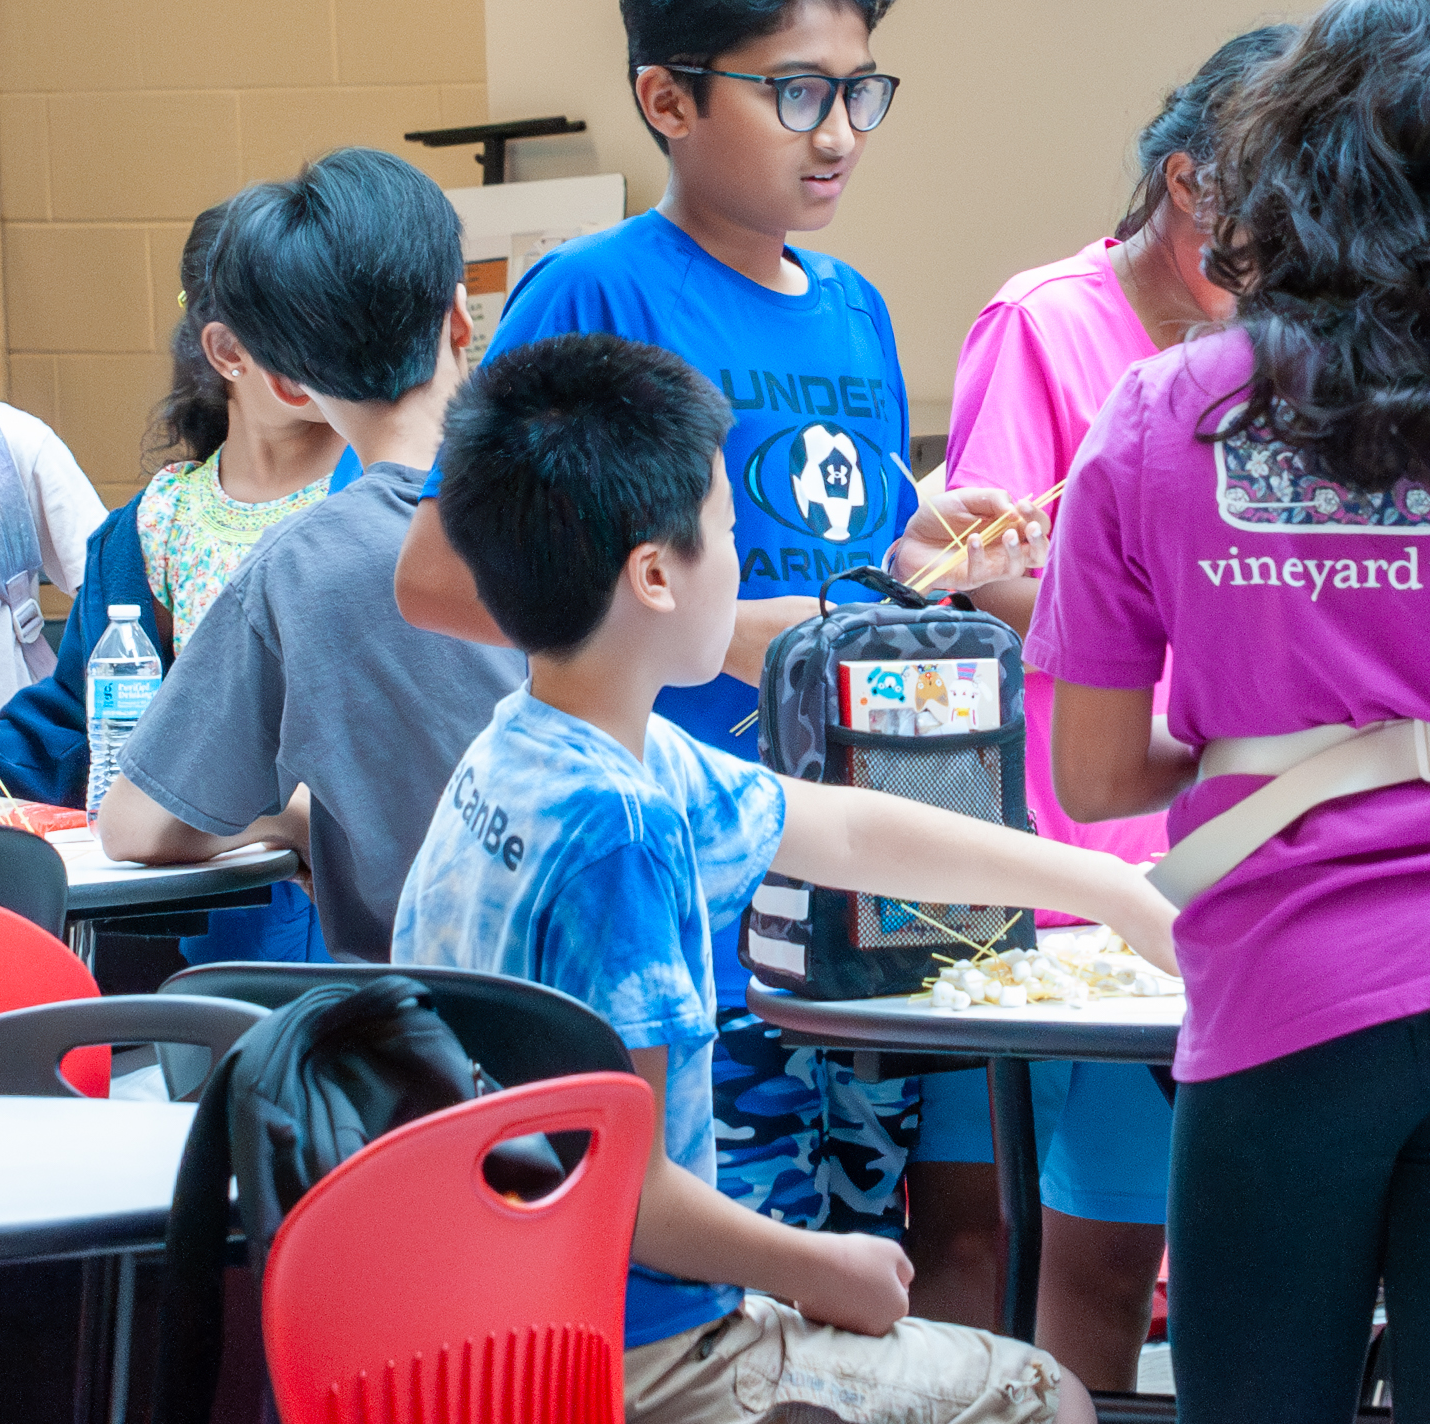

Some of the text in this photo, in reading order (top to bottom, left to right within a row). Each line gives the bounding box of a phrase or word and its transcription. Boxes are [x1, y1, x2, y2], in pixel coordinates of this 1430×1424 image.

[719, 368, 889, 423] UNDER
[1198, 546, 1423, 602] vineyard
[453, 765, 525, 872] CanBe
